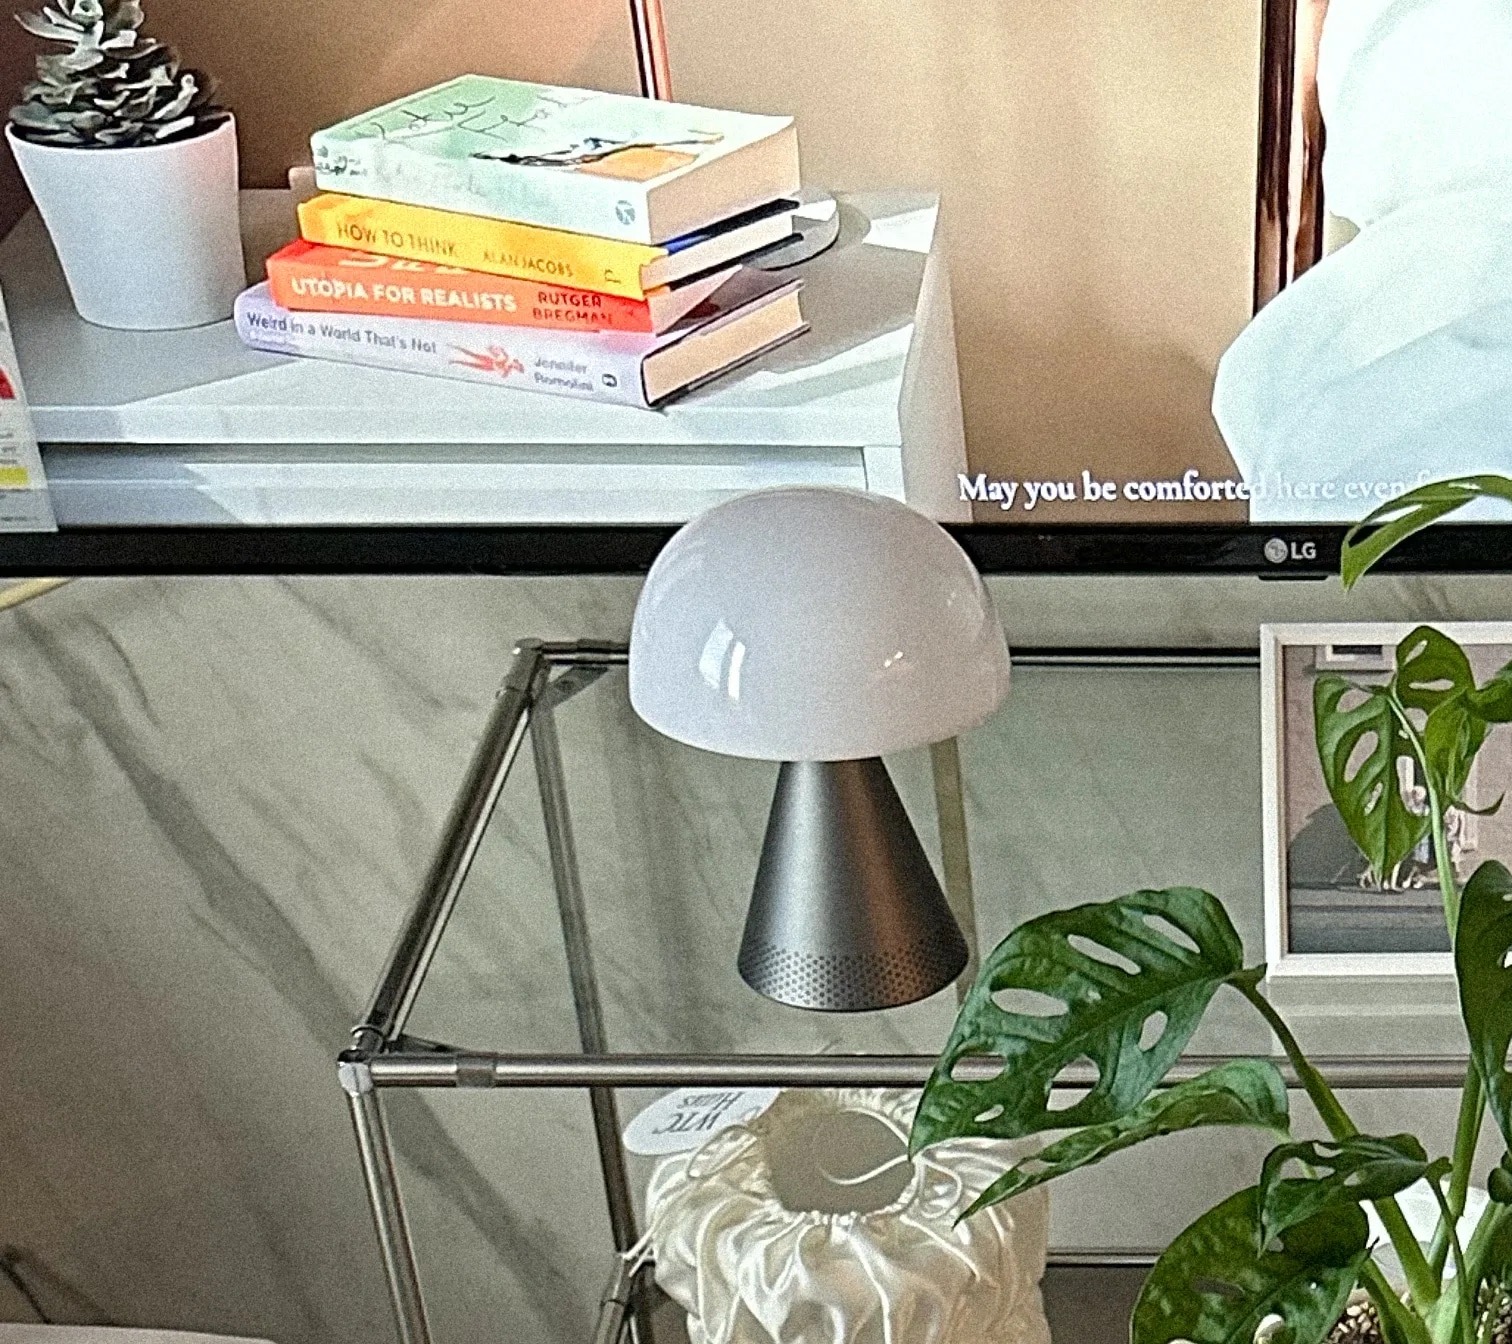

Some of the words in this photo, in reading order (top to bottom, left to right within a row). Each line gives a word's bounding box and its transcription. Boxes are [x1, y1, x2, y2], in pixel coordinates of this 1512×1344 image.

[337, 223, 378, 244] HOW
[381, 229, 405, 248] TO
[408, 233, 457, 257] THINK
[291, 278, 368, 303] UTOPIA
[372, 285, 415, 304] FOR
[420, 288, 517, 312] REALISTS
[538, 291, 601, 308] RUTGER
[246, 312, 286, 332] Weird
[320, 324, 360, 343] World
[364, 331, 407, 350] That's
[411, 337, 437, 354] Not
[532, 307, 612, 325] BREGMAN
[957, 473, 1019, 510] May
[1022, 482, 1077, 510] you
[1081, 470, 1117, 501] be
[1122, 469, 1267, 501] comforted
[1278, 472, 1334, 499] here
[1344, 480, 1405, 499] even
[1290, 541, 1317, 560] LG
